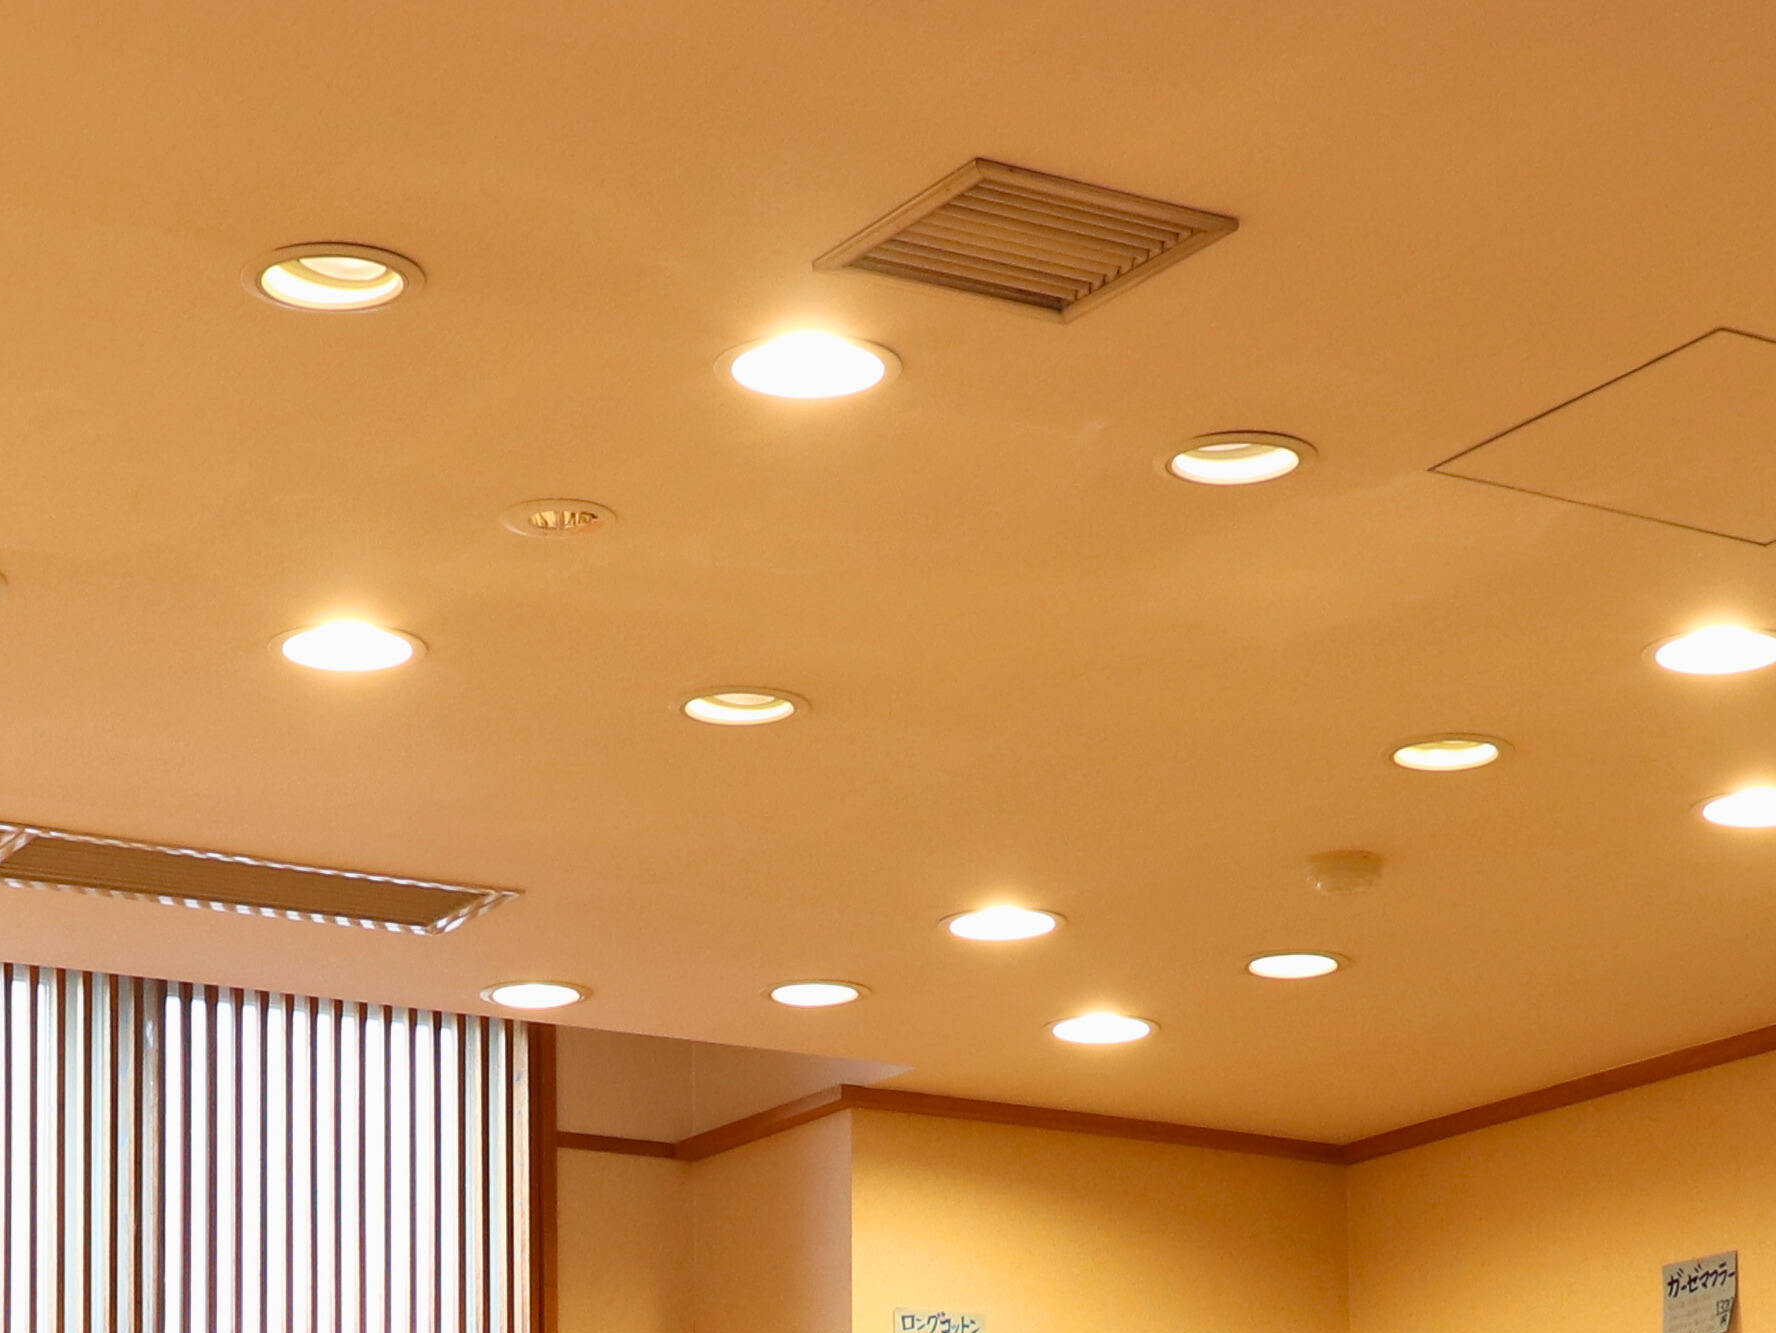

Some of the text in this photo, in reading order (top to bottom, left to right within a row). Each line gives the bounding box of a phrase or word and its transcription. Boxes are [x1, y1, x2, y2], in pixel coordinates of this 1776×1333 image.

[1667, 1262, 1736, 1298] ガーゼマフラー
